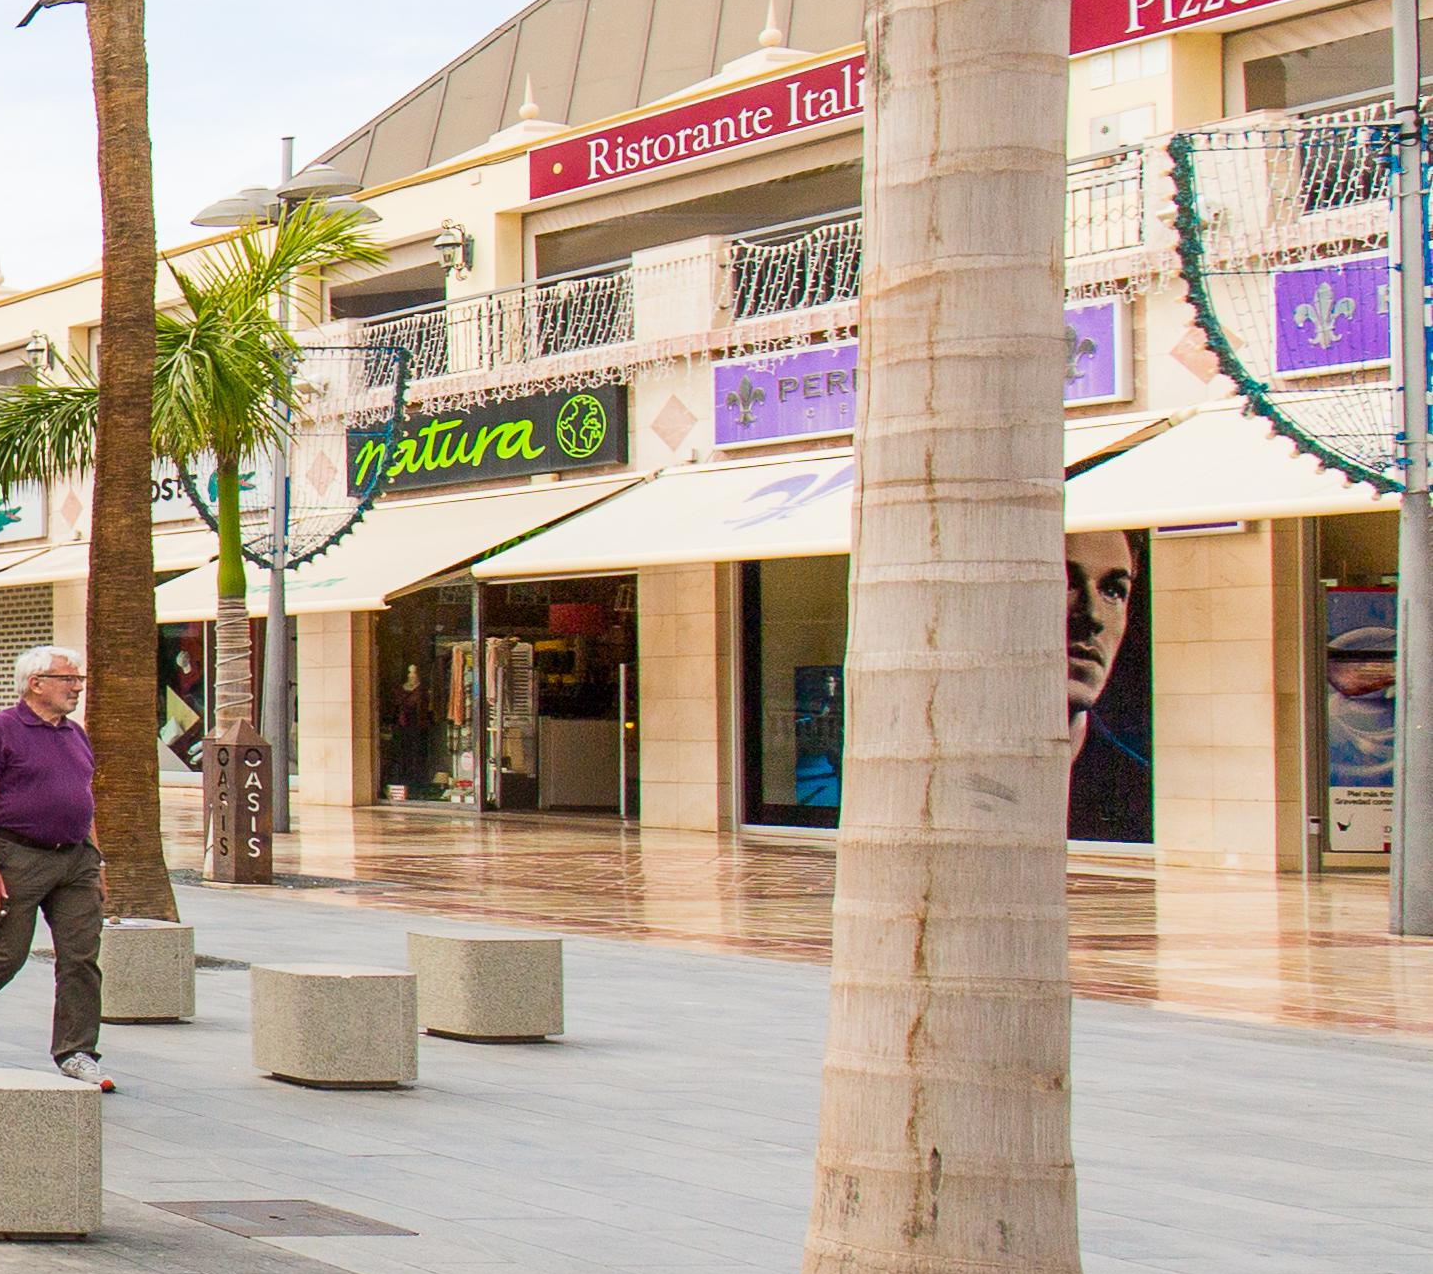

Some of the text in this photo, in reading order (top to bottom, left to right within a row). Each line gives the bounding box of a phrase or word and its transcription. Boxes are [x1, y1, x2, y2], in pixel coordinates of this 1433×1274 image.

[586, 63, 866, 180] Ristorante Itali
[354, 418, 546, 487] natura
[217, 747, 230, 857] OASIS
[243, 747, 263, 859] OASIS
